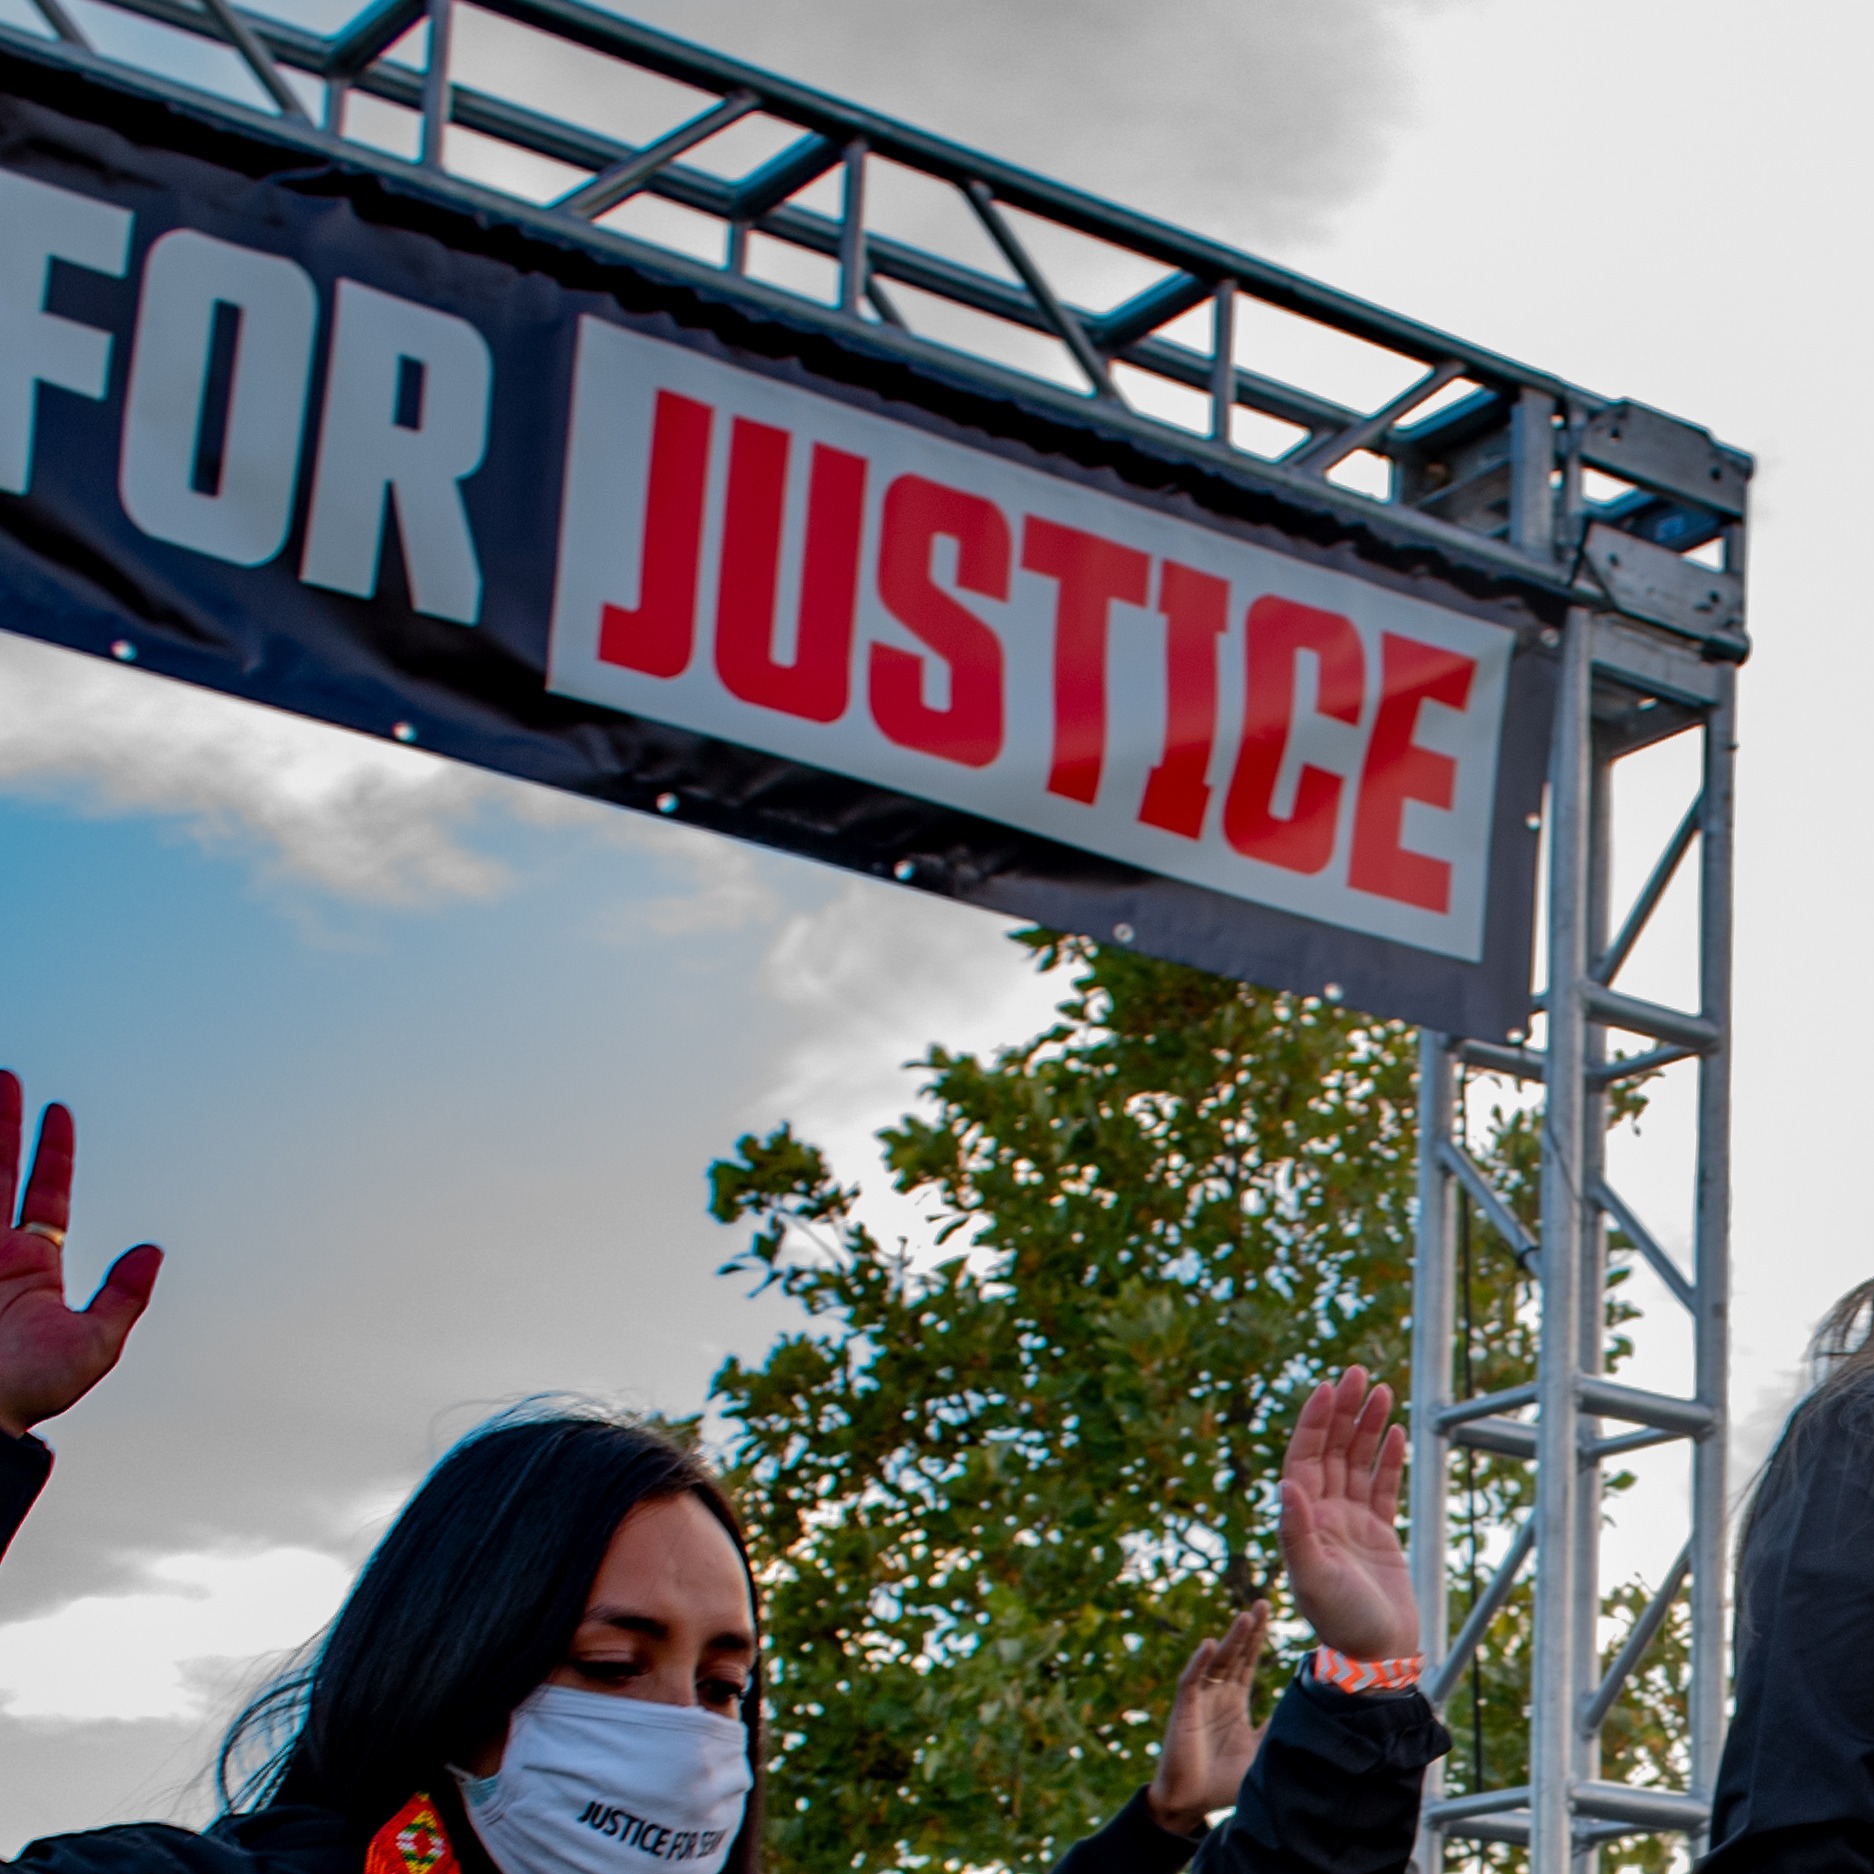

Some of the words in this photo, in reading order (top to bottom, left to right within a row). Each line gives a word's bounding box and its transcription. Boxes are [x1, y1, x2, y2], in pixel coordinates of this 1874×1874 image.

[0, 169, 493, 627] FOR
[598, 388, 1477, 916] JUSTICE
[577, 1801, 672, 1857] JUSTICE
[665, 1832, 698, 1861] FOR
